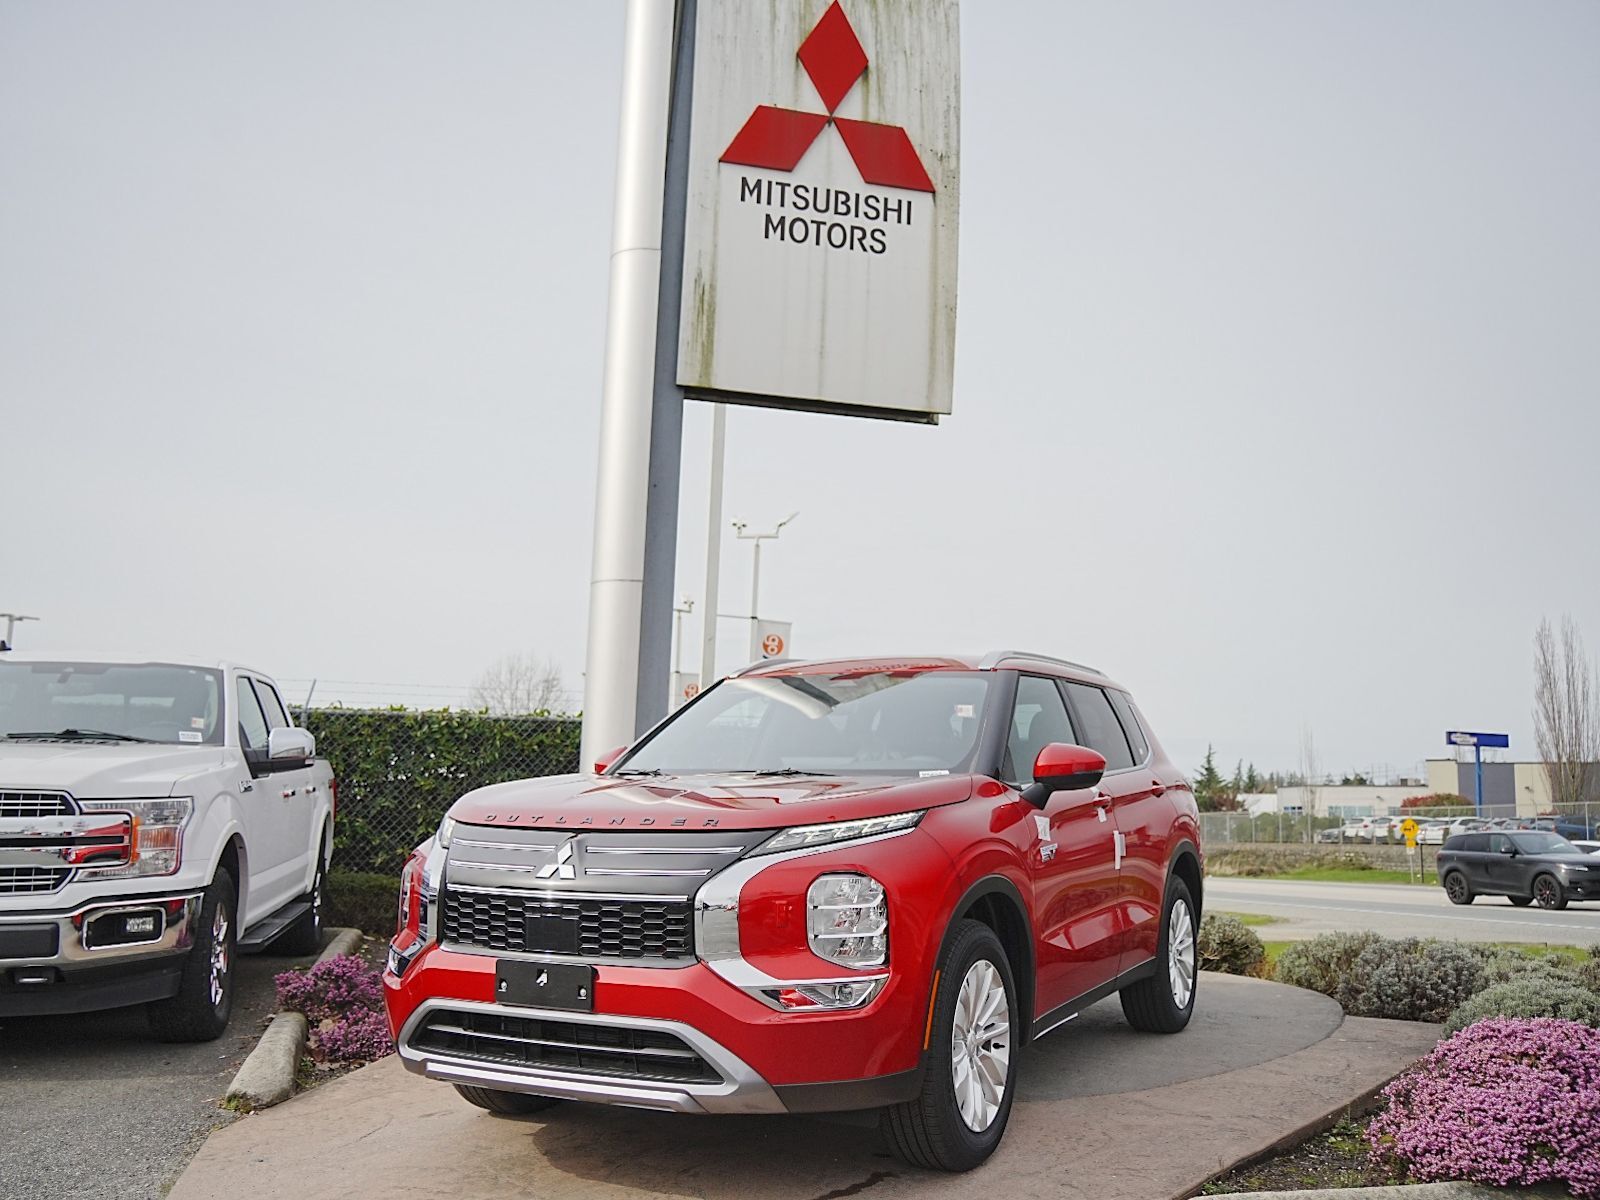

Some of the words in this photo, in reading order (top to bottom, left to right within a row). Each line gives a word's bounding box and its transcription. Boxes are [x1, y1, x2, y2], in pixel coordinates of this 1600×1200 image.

[740, 176, 912, 225] MITSUBISHI
[764, 213, 887, 254] MOTORS
[484, 813, 720, 828] OUTLANDER
